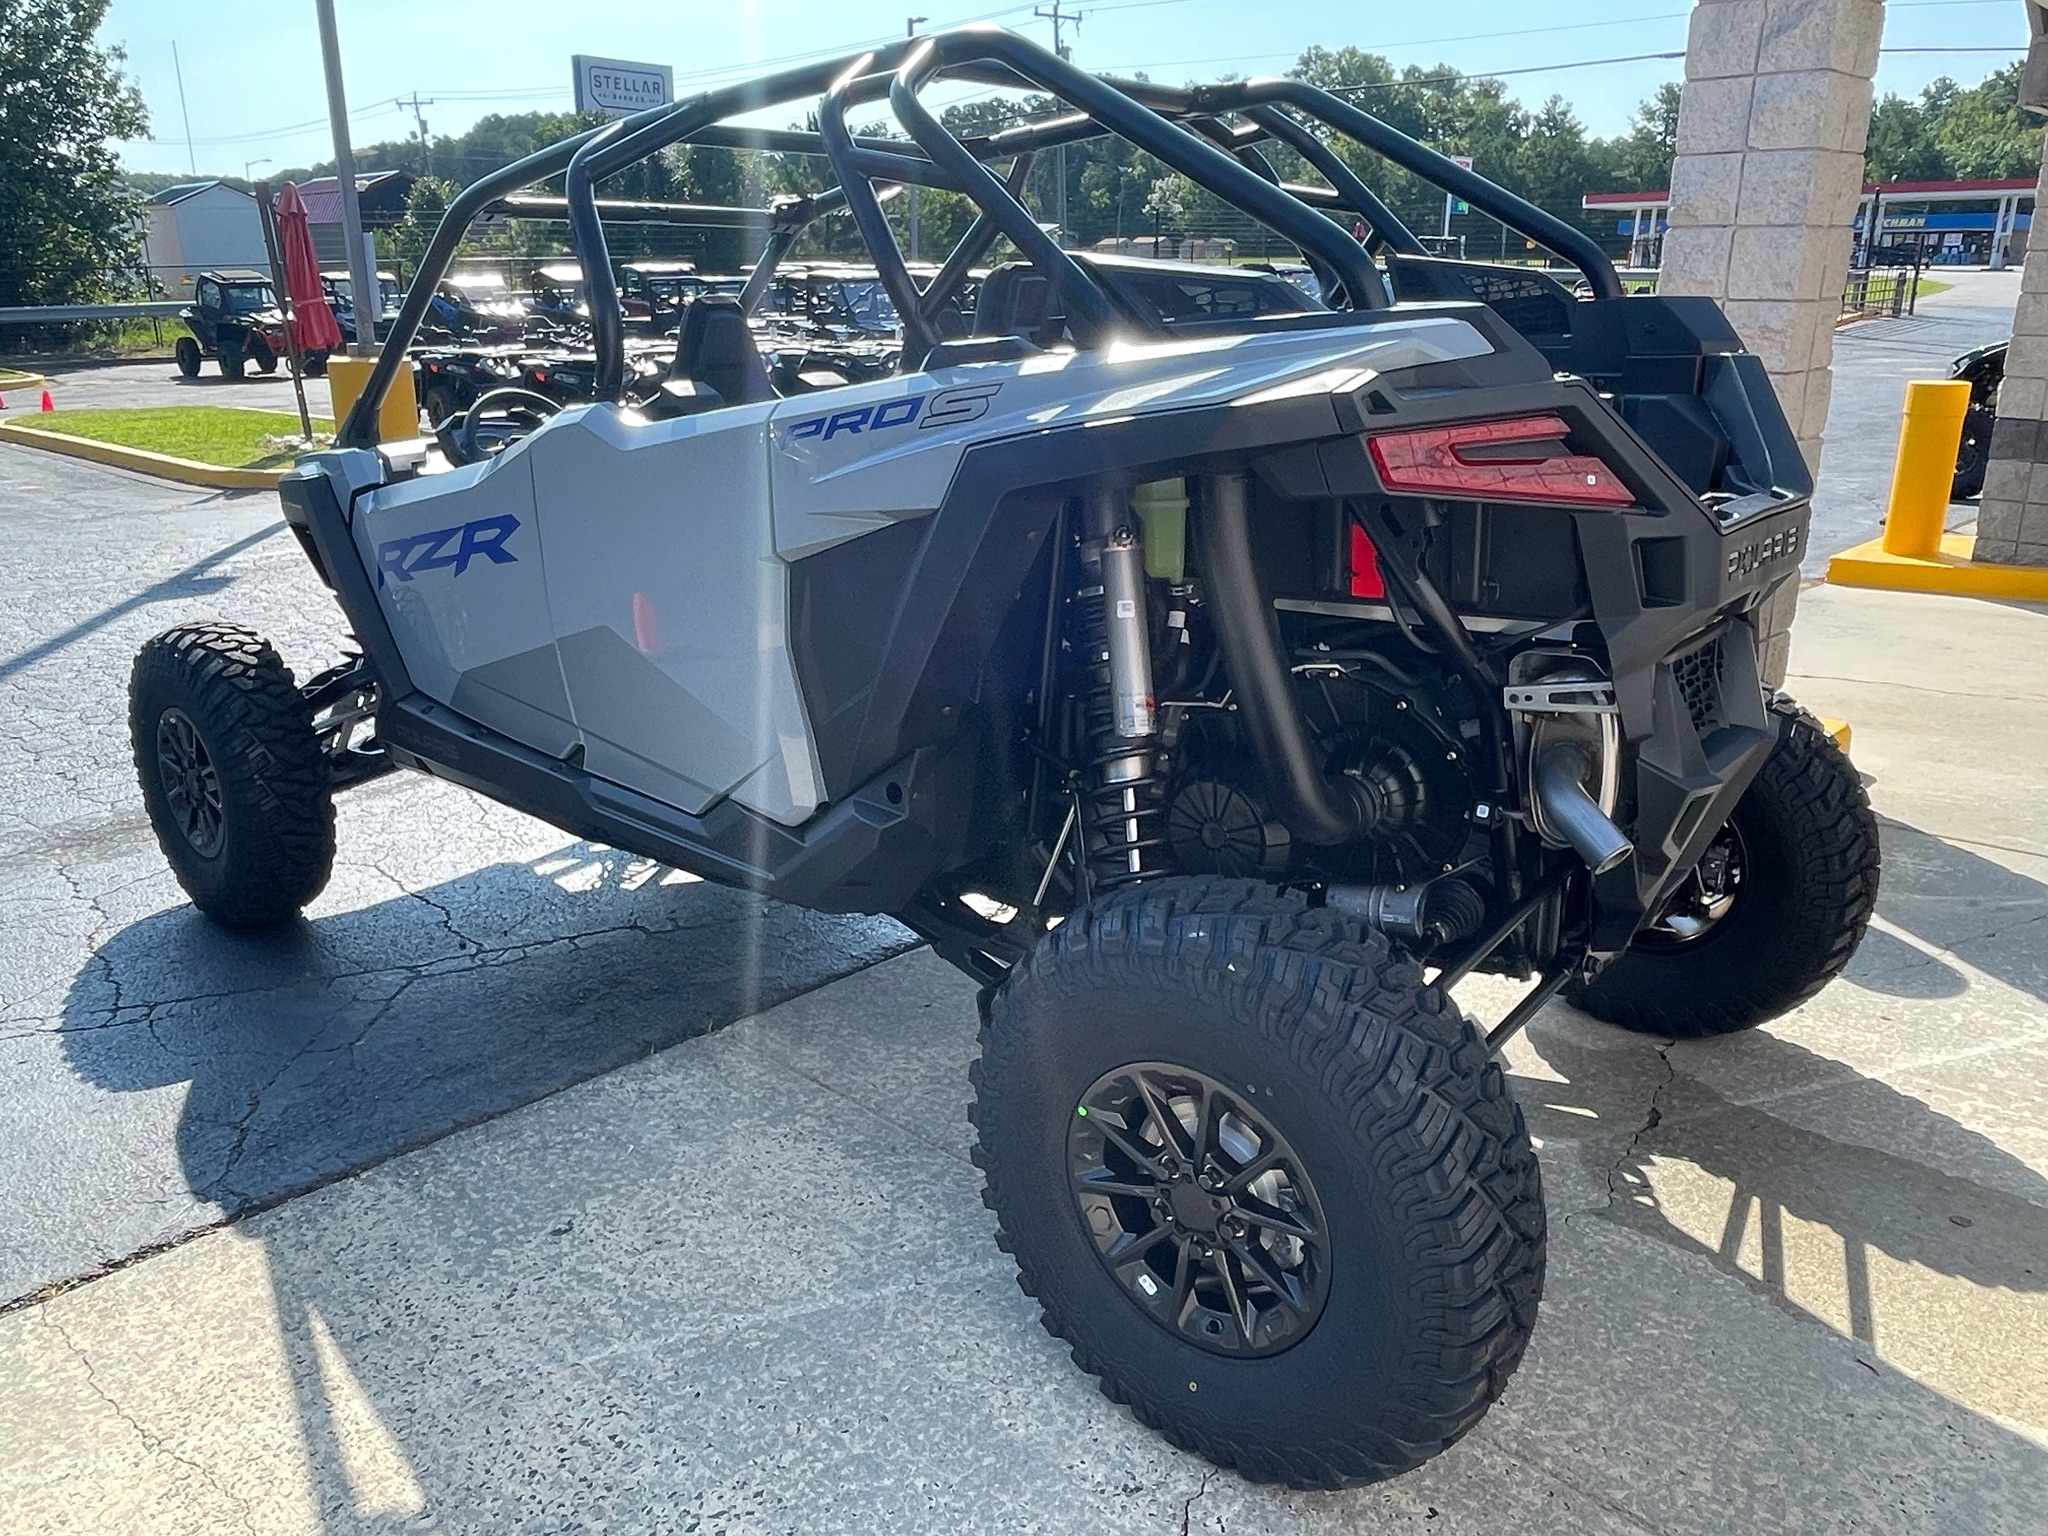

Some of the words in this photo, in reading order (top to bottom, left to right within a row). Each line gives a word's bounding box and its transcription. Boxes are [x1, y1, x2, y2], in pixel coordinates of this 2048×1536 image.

[594, 74, 660, 95] STELLAR
[780, 396, 927, 451] PRO
[919, 382, 1004, 430] S
[377, 512, 521, 591] RZR
[1728, 526, 1799, 581] POLARIS
